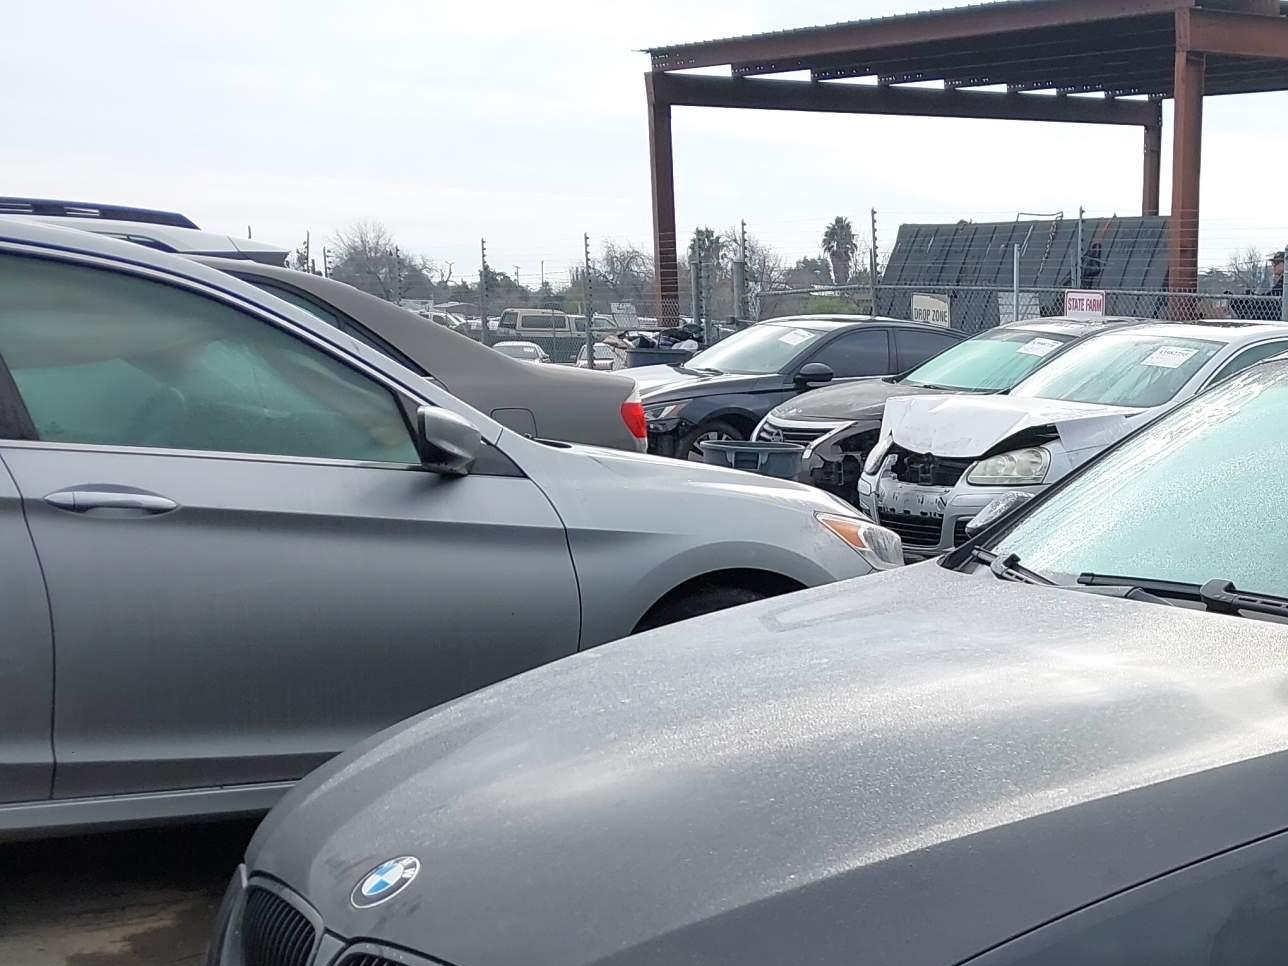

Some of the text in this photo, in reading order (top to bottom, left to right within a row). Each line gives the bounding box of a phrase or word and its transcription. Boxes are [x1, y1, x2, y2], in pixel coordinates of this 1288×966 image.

[1068, 297, 1102, 312] STATE FARM
[914, 307, 948, 322] DROP ZONE
